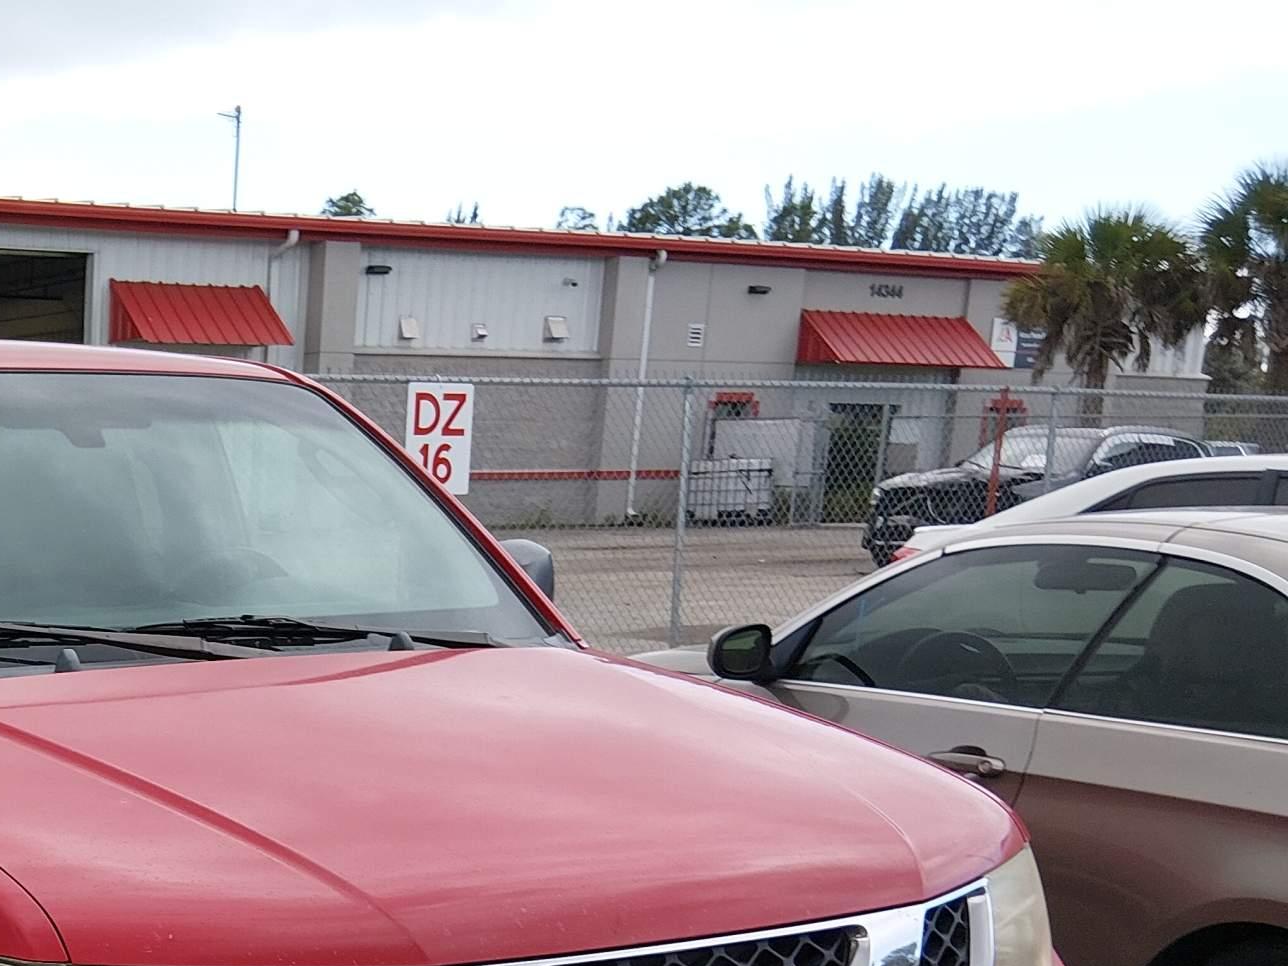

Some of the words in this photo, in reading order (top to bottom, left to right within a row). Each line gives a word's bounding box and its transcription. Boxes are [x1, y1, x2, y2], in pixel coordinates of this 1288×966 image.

[869, 283, 904, 299] 14344
[413, 391, 467, 437] DZ
[418, 443, 453, 485] 16
